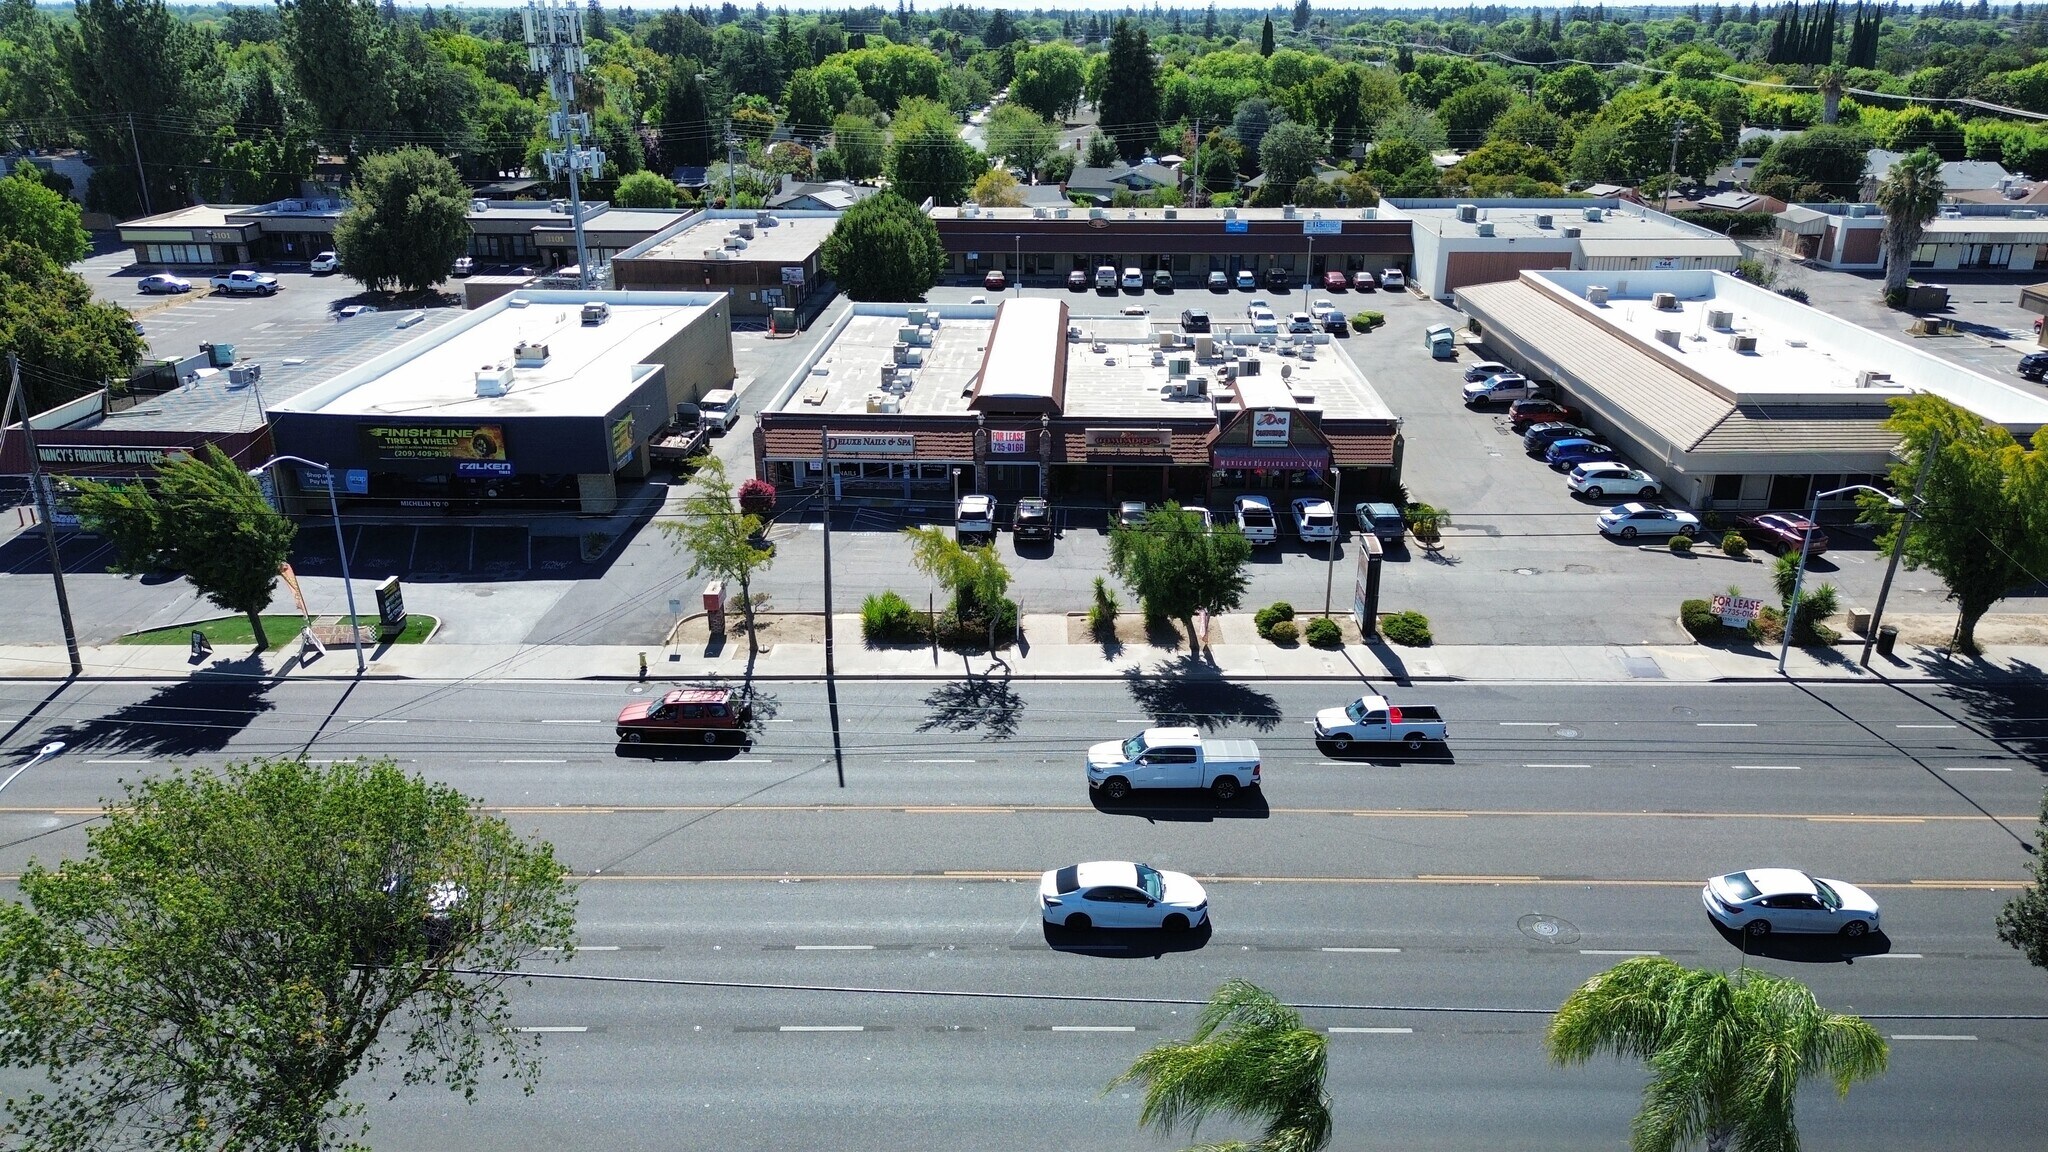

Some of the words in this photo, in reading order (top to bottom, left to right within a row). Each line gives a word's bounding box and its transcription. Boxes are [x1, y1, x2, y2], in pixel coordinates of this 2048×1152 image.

[379, 427, 431, 438] FINISH
[438, 428, 474, 438] LINE
[992, 431, 1005, 442] FOR
[1006, 432, 1024, 442] LEASE
[385, 437, 411, 445] TIRES
[420, 437, 458, 446] WHEELS
[888, 437, 896, 446] &
[993, 442, 1024, 452] 735-0166
[39, 449, 74, 462] NANCY'S
[75, 449, 116, 463] FURNITURE
[117, 451, 123, 463] &
[394, 450, 416, 458] (209)
[459, 462, 511, 470] FALKEN
[1712, 595, 1732, 607] FOR
[1733, 598, 1760, 611] LEASE
[1711, 606, 1758, 619] 209-735-0166
